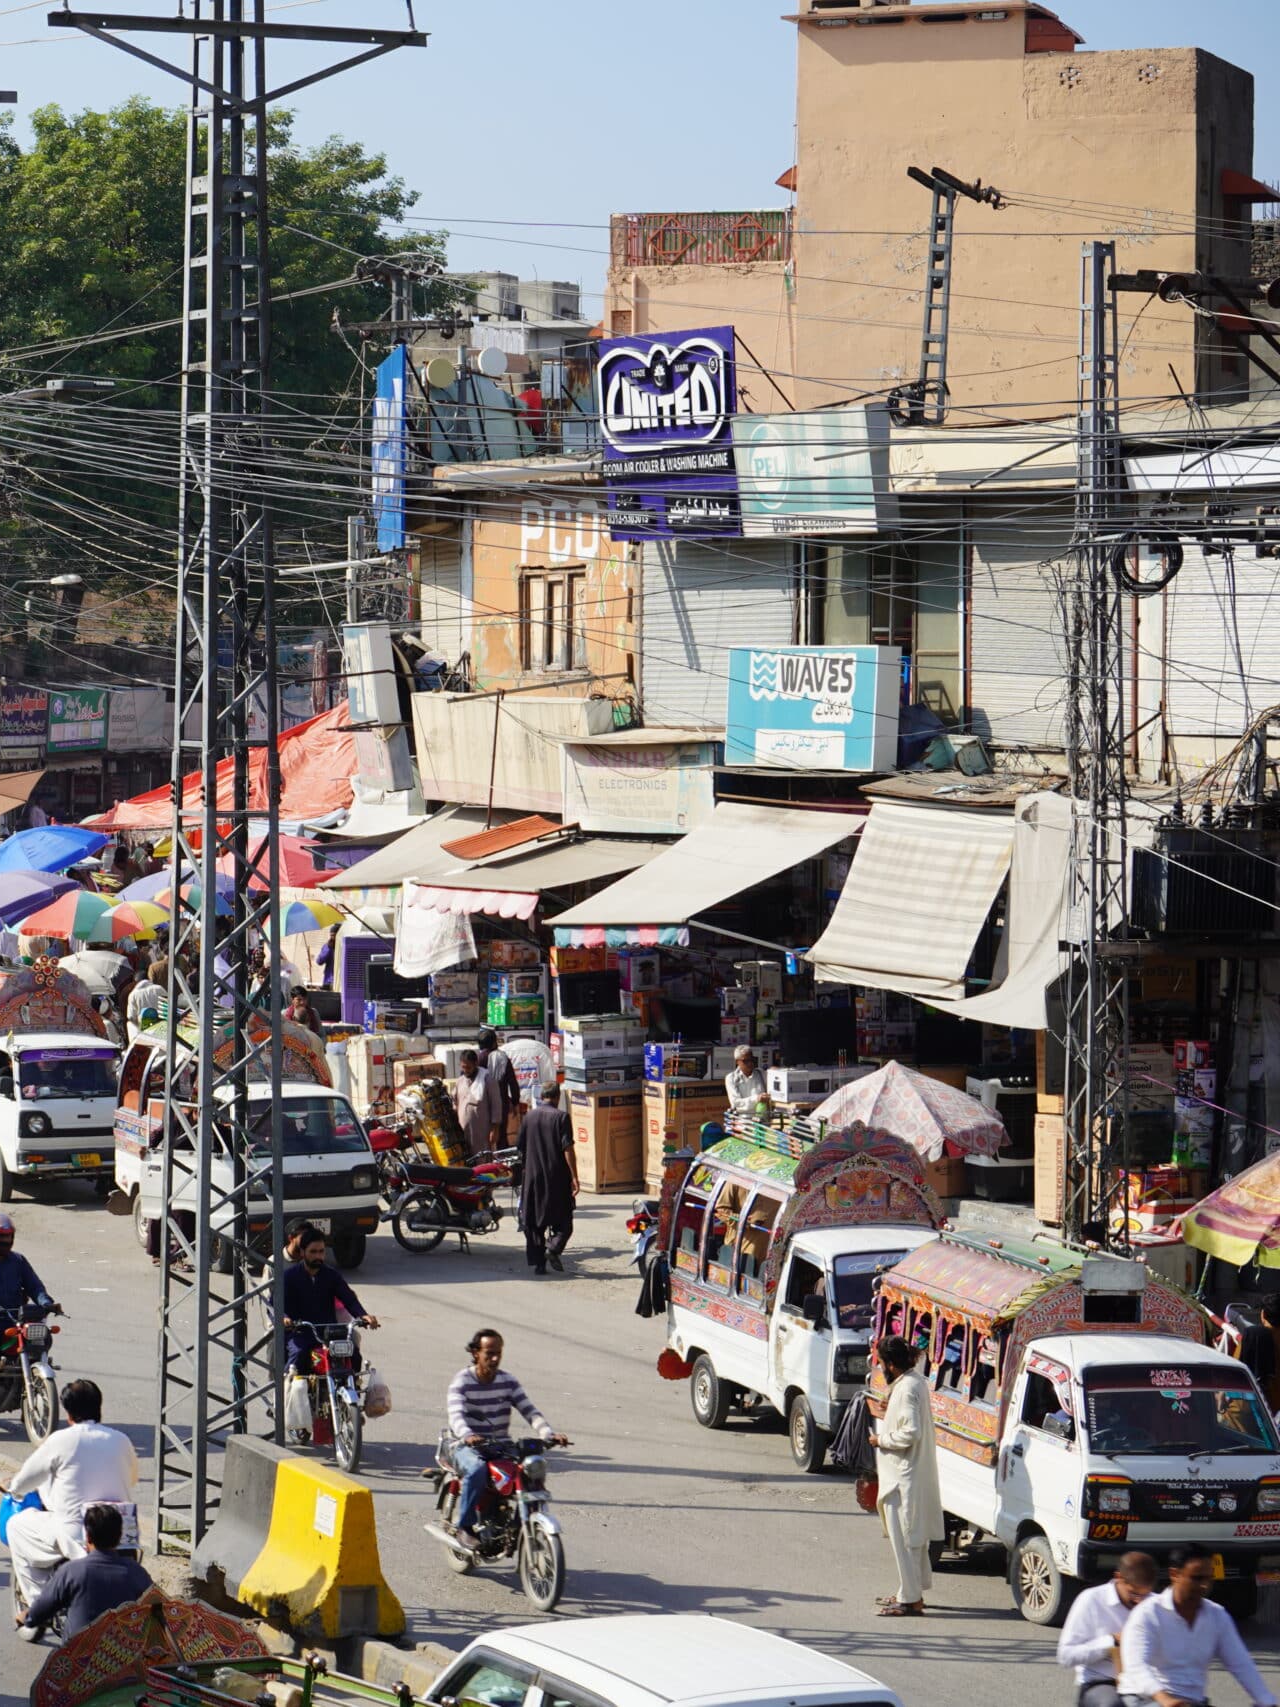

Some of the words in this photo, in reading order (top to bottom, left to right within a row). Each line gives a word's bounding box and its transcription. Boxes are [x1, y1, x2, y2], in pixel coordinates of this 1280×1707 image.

[606, 362, 718, 433] UNITED
[635, 459, 660, 473] COOLER
[666, 455, 697, 471] WASHING
[698, 452, 729, 469] MACHINE
[753, 454, 785, 478] PEL
[780, 658, 854, 693] WAVES
[598, 778, 668, 791] ELECTRONICS
